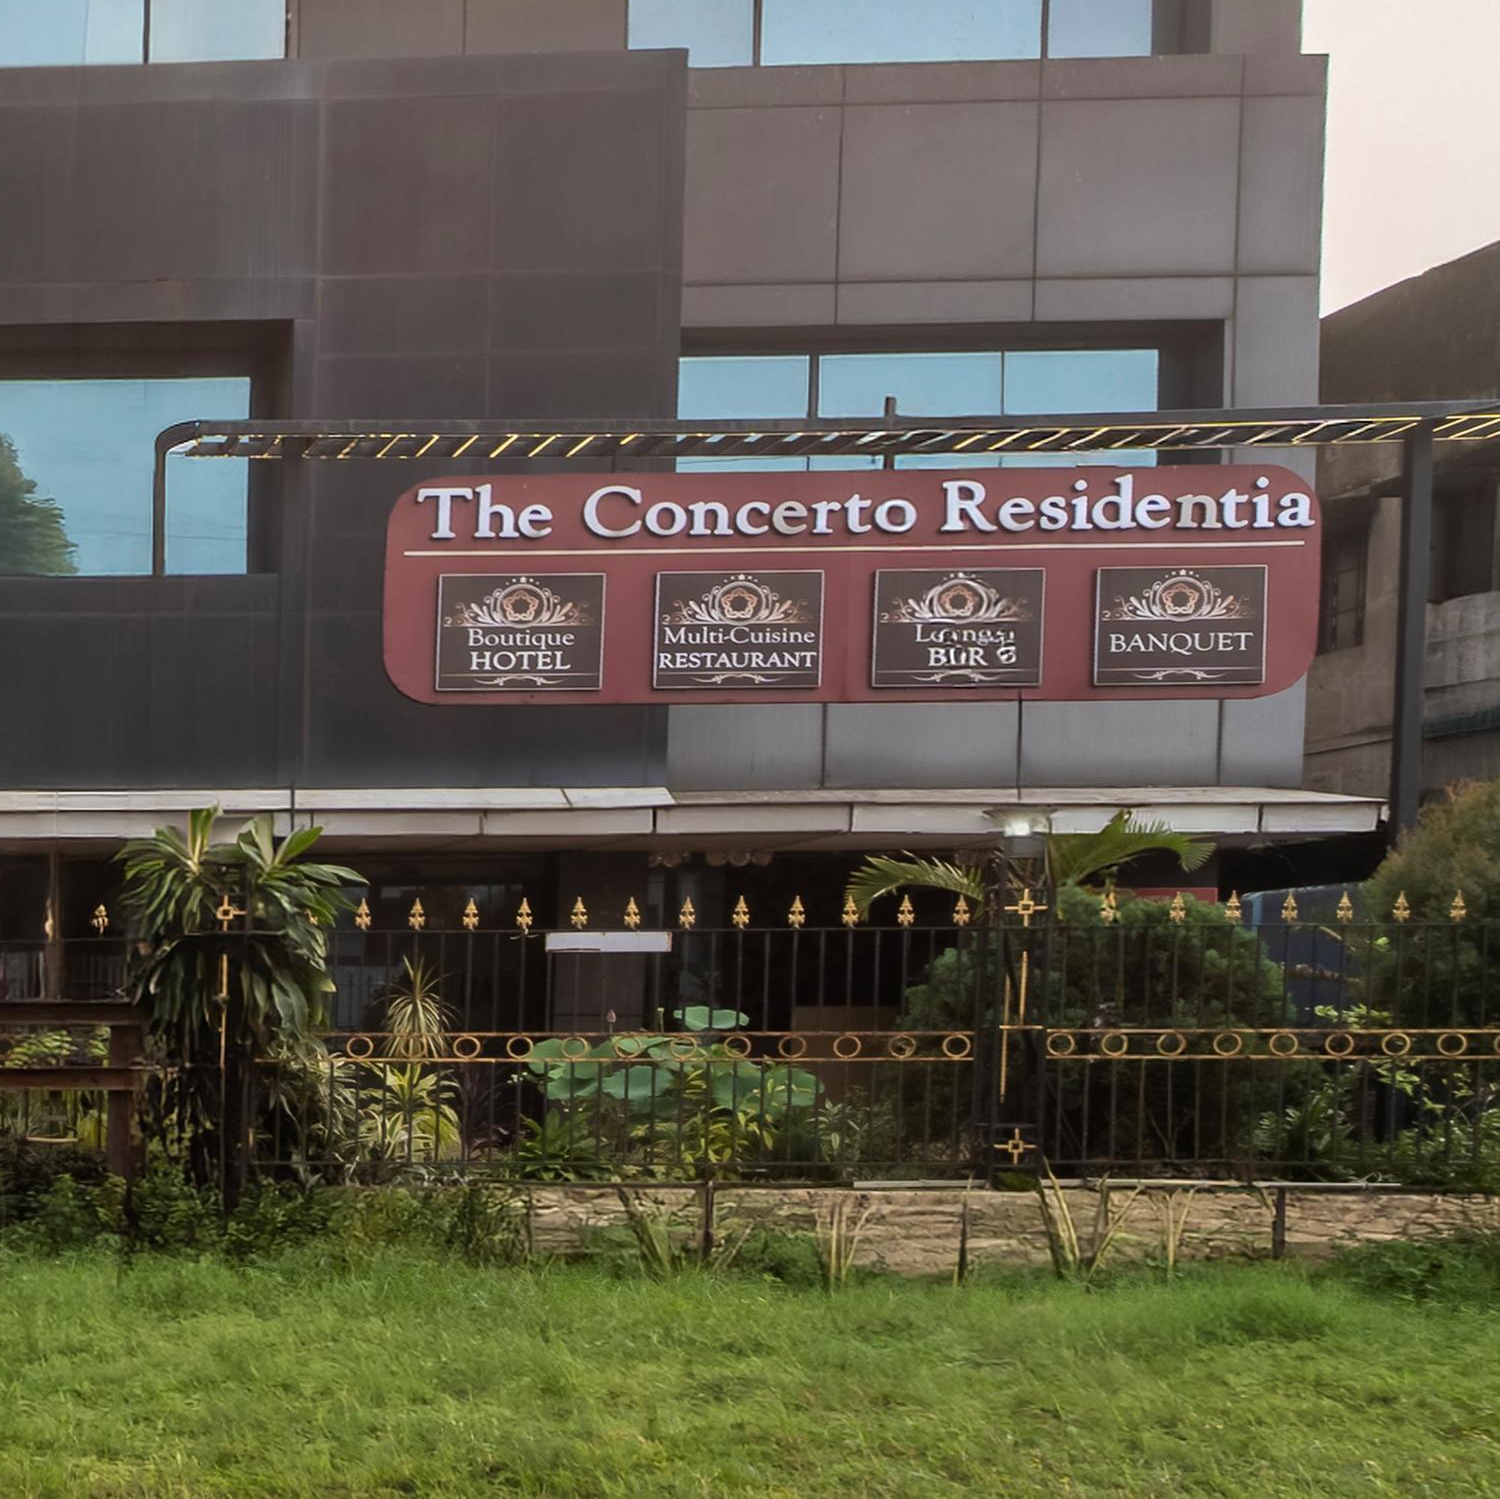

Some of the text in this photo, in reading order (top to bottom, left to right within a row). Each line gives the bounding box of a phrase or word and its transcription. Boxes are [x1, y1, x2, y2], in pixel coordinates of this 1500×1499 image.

[417, 473, 1316, 540] The Concerto Residentia
[467, 627, 576, 650] Boutique
[663, 626, 816, 645] Multi-Cuisine
[1108, 631, 1254, 655] BANQUET
[469, 650, 572, 671] HOTEL
[658, 651, 818, 669] RESTAURANT
